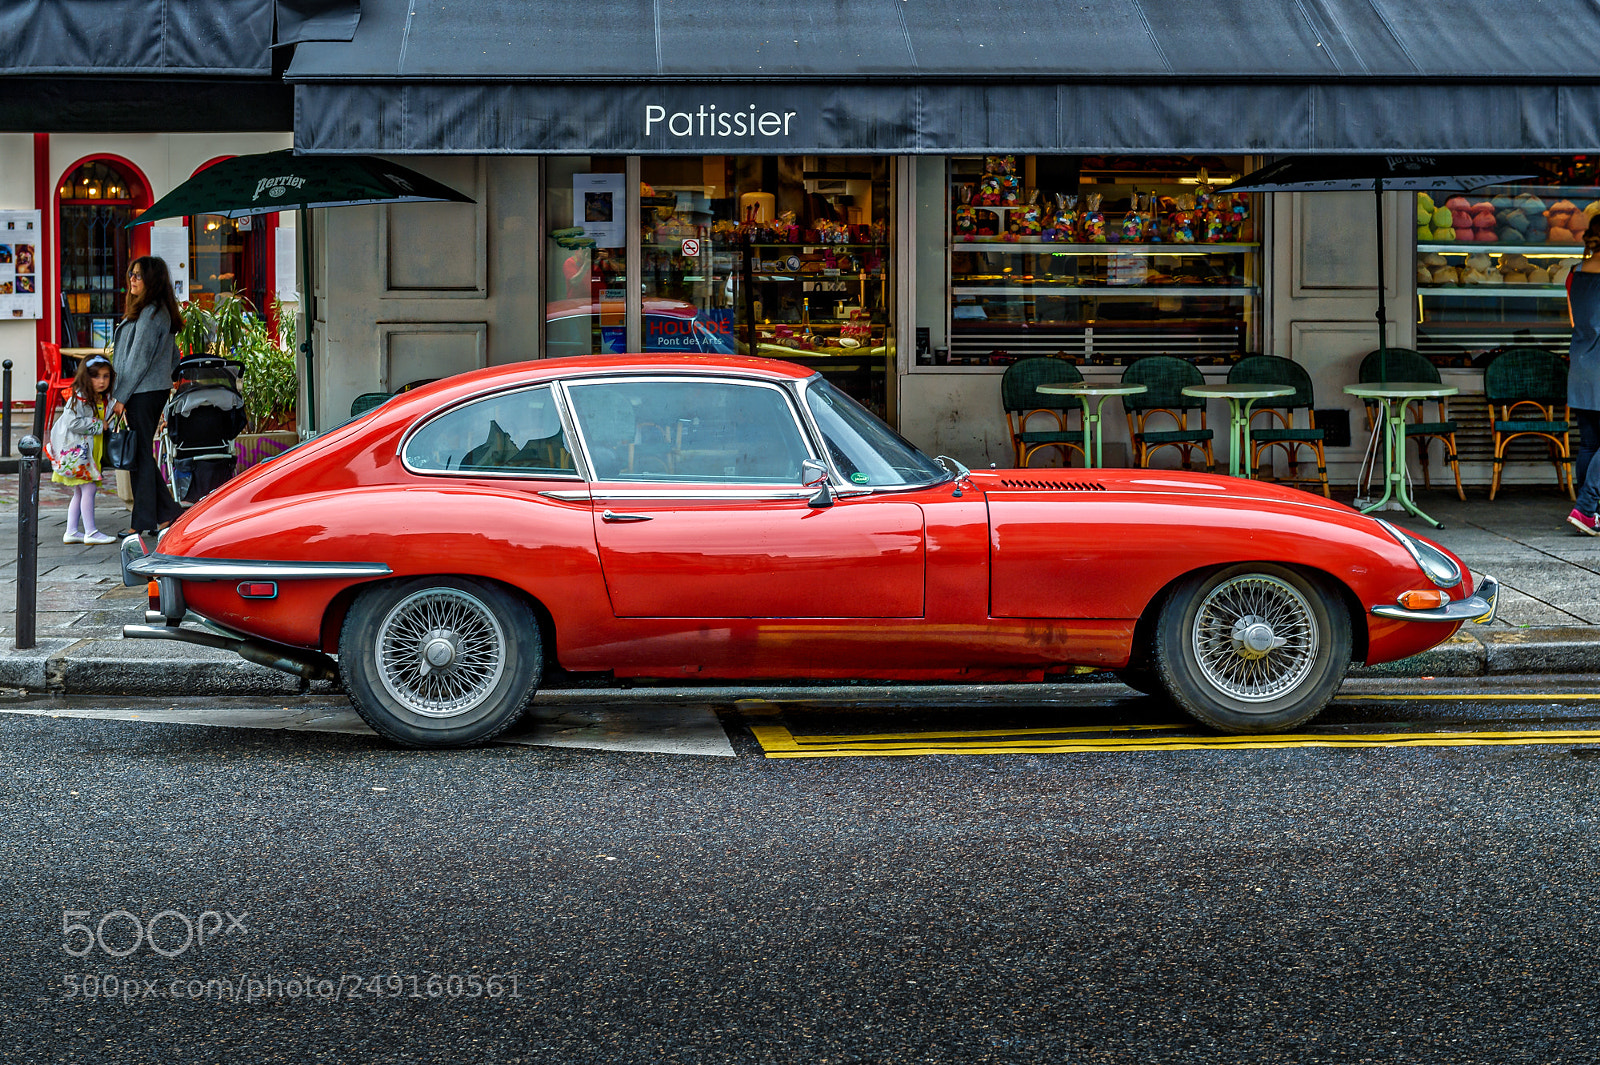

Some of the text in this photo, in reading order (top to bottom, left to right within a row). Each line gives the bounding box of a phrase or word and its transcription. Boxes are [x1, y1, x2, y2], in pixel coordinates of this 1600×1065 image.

[645, 104, 797, 137] Patissier
[657, 337, 723, 346] Pont des Arts
